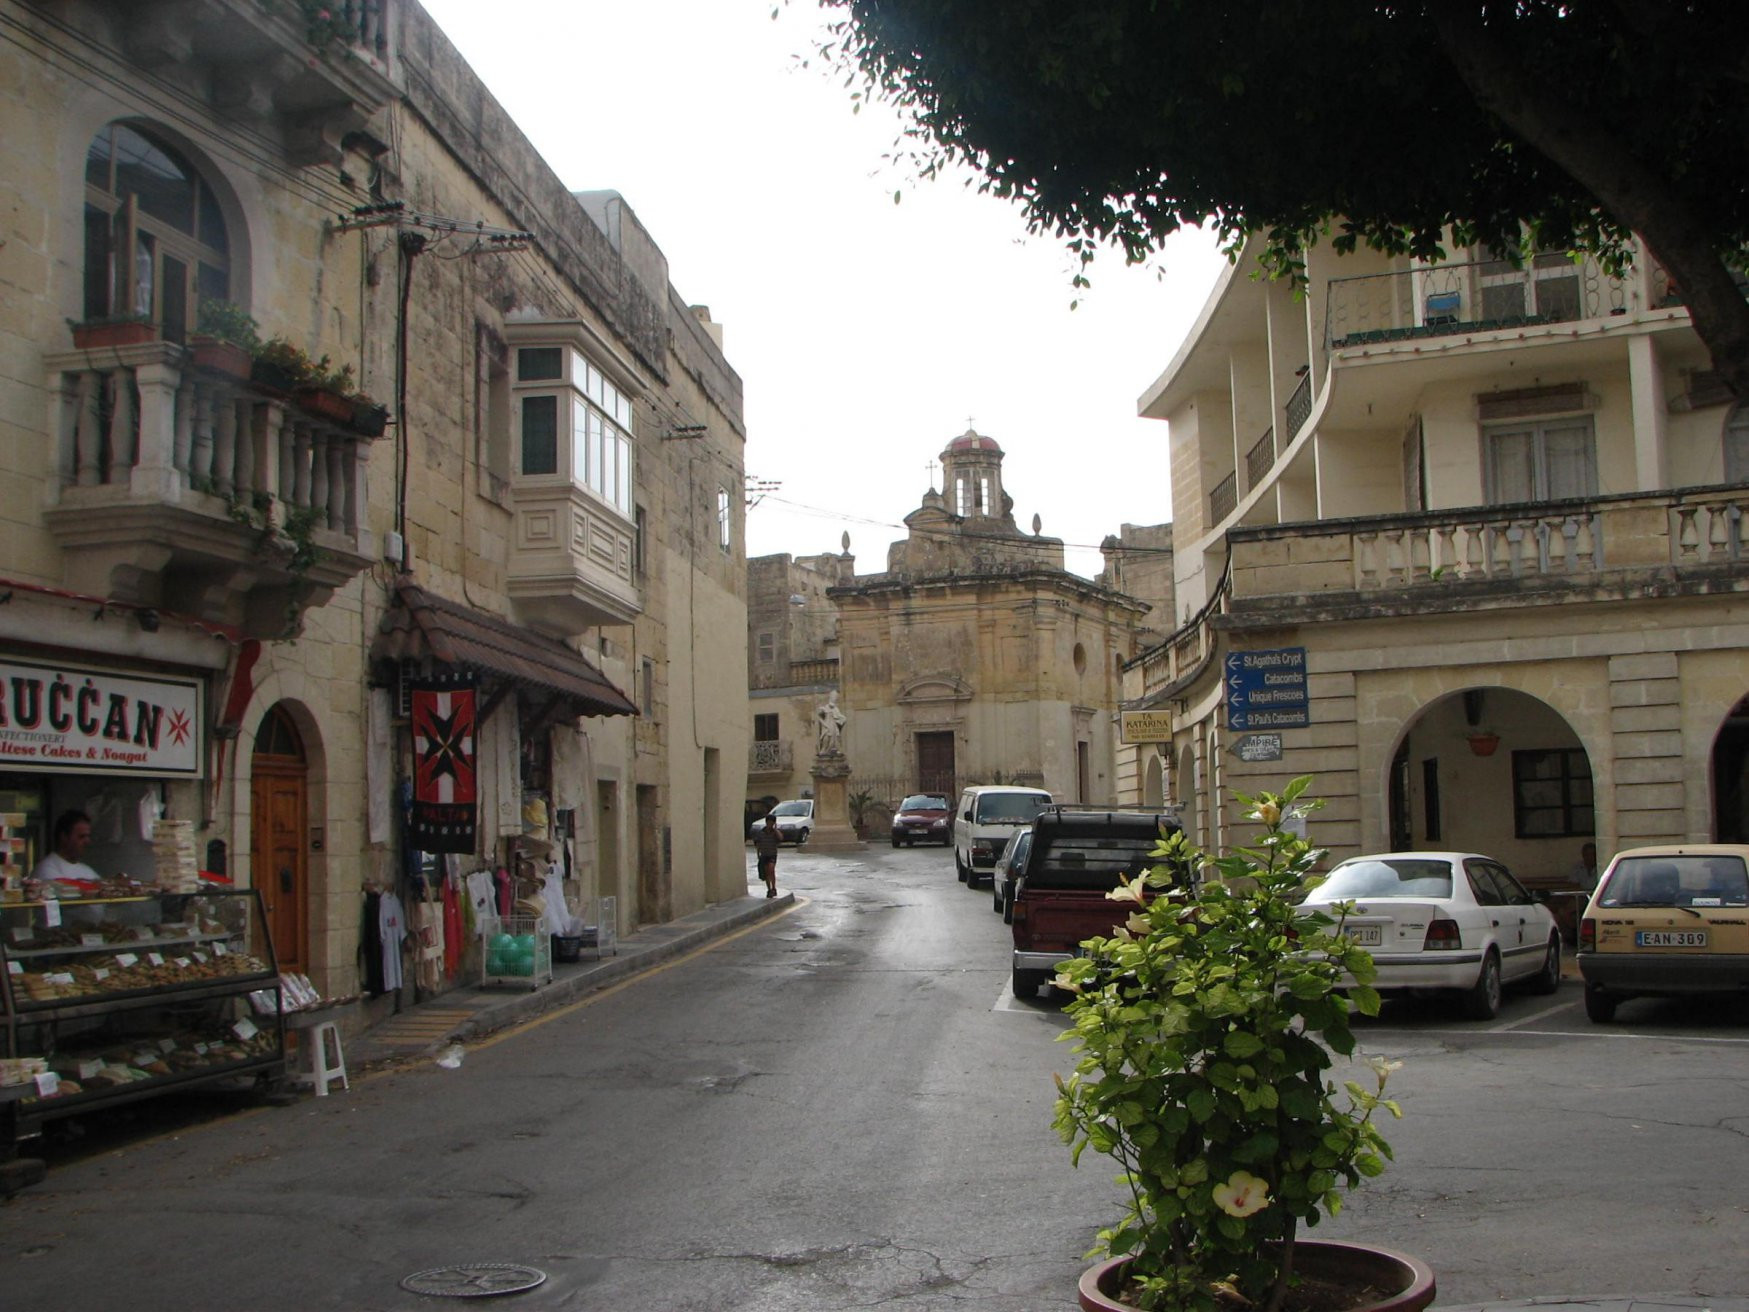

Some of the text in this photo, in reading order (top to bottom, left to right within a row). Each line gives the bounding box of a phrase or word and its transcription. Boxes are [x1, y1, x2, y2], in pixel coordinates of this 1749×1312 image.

[1281, 652, 1302, 667] Crypt
[1264, 672, 1304, 685] Catacombs
[1248, 689, 1304, 704] Unique Frescoes
[0, 673, 164, 751] UĊĊAN
[1272, 711, 1305, 724] Catacombs
[1126, 719, 1168, 729] KATARINA
[41, 743, 82, 758] Cakes
[86, 746, 97, 759] &
[101, 747, 148, 764] Nougat
[1643, 933, 1671, 945] EAN
